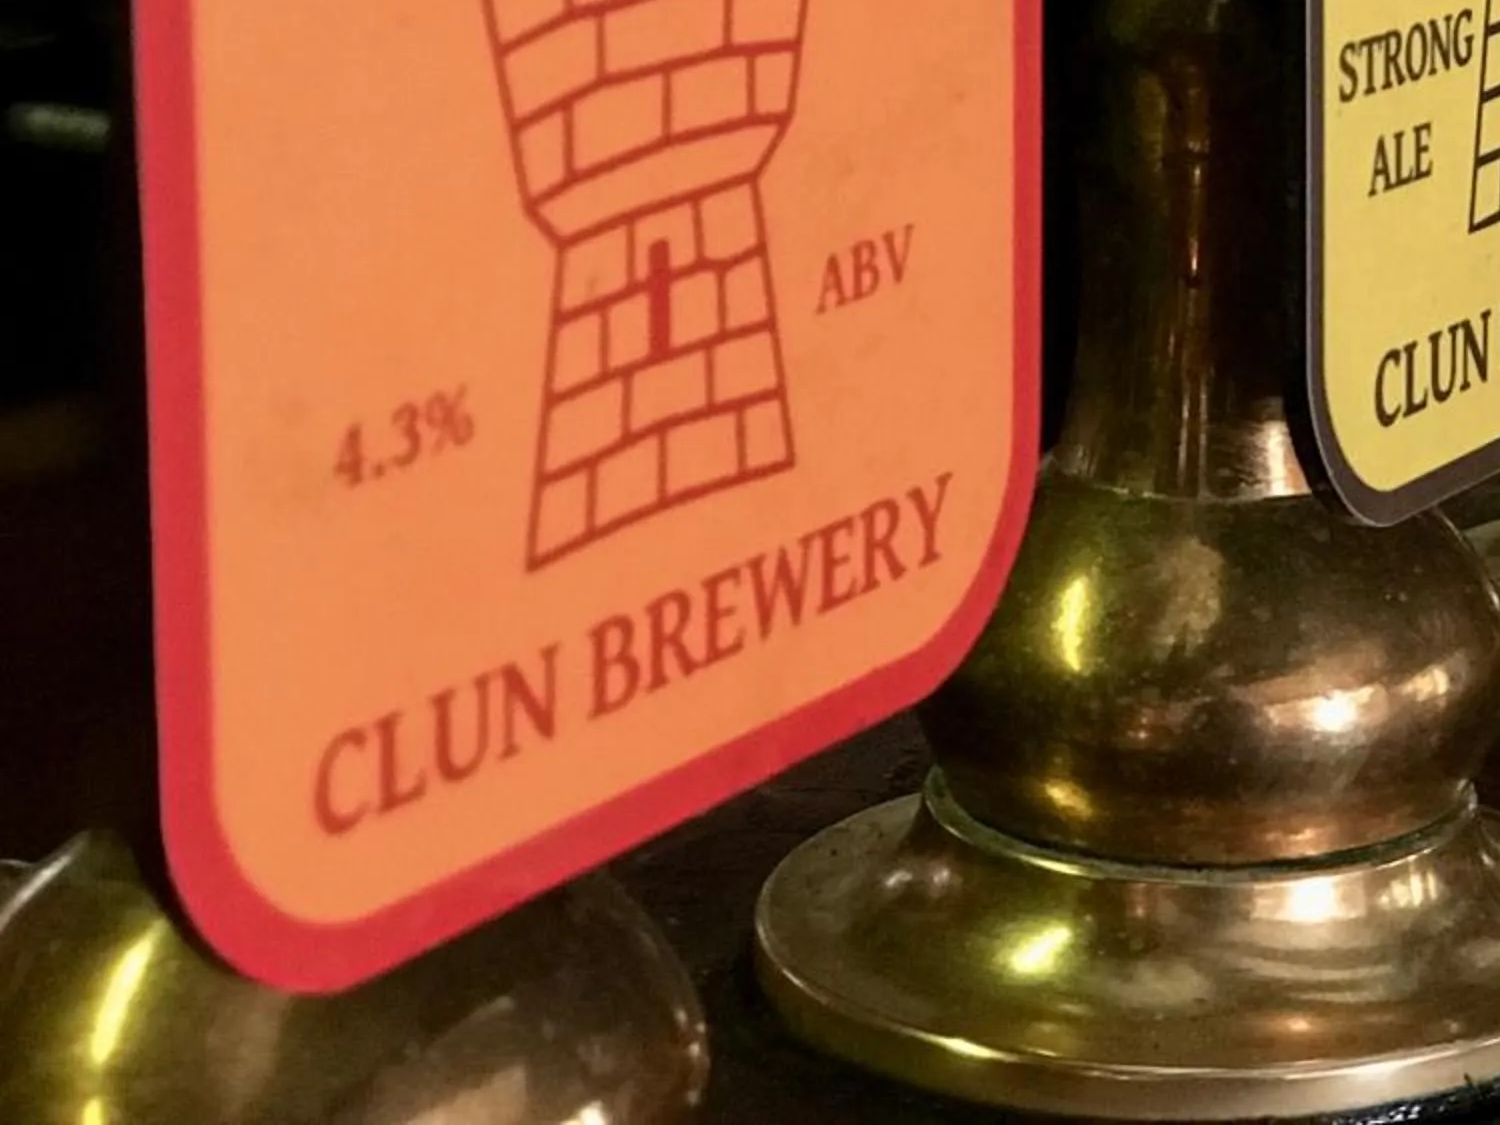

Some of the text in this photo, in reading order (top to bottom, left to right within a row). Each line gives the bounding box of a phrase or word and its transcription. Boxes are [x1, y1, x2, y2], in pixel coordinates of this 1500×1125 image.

[1339, 9, 1474, 103] STRONG
[1368, 122, 1433, 197] ALE
[814, 224, 914, 314] ABV
[1374, 310, 1492, 428] CLUN
[332, 384, 475, 488] 4.3%
[312, 472, 953, 838] CLUN BREWERY
